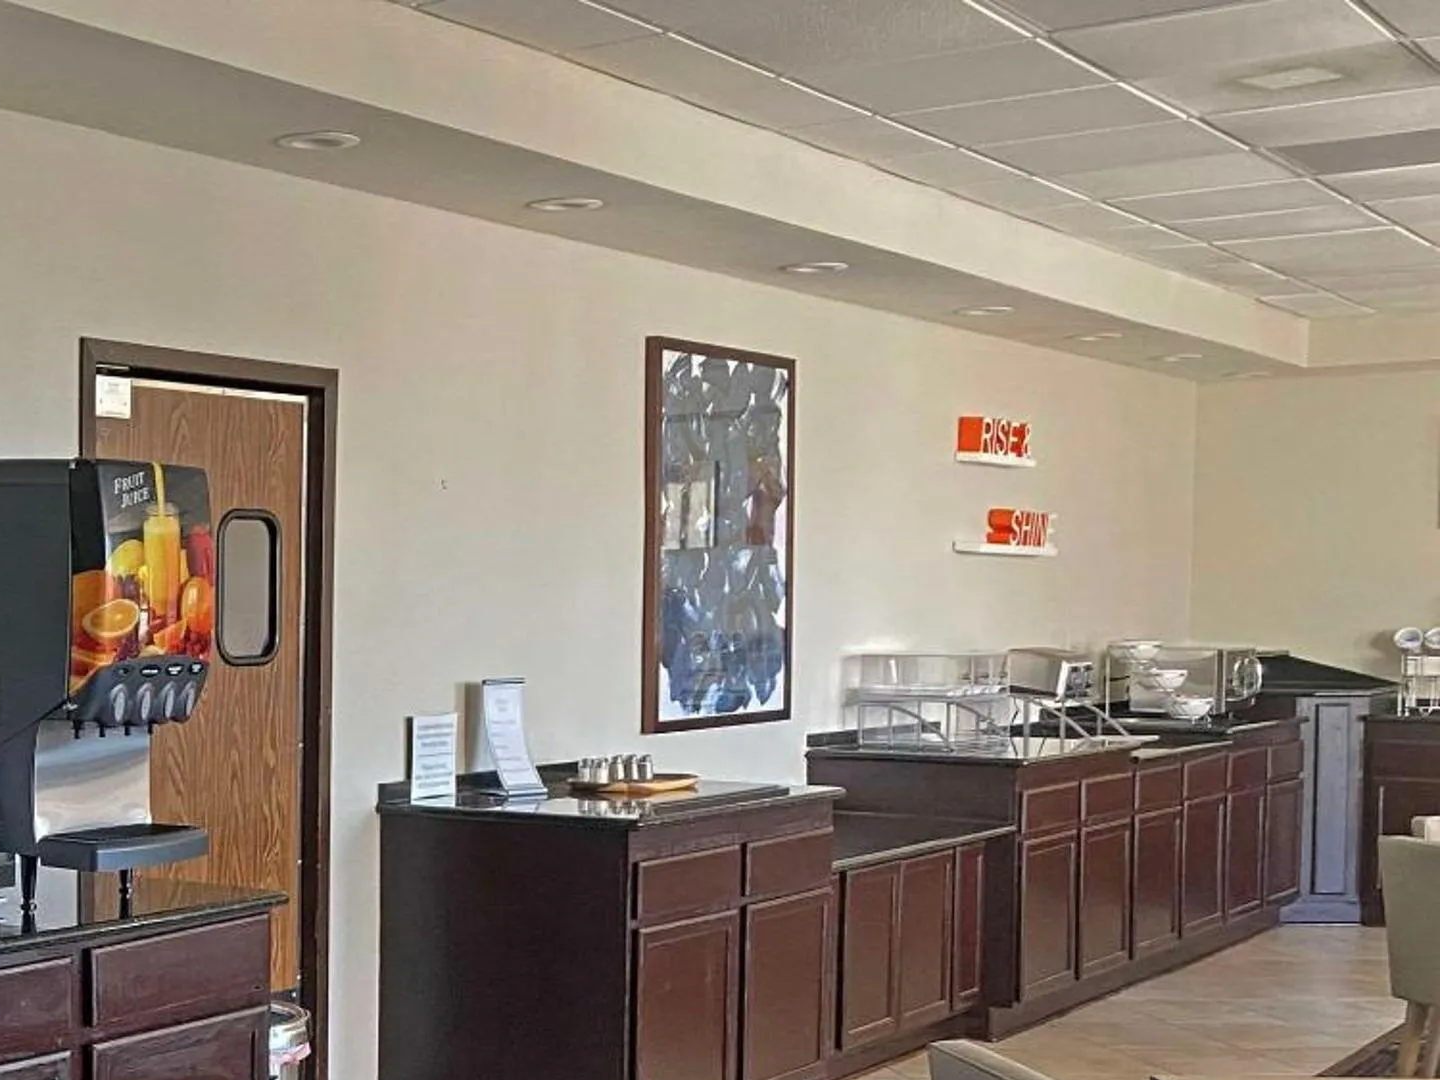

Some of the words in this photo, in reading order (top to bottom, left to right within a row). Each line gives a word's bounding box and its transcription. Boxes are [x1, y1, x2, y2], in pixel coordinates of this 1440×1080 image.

[981, 417, 1020, 458] RISE
[114, 471, 145, 494] FRUIT
[121, 487, 150, 508] JUICE
[1009, 510, 1058, 549] SHINE
